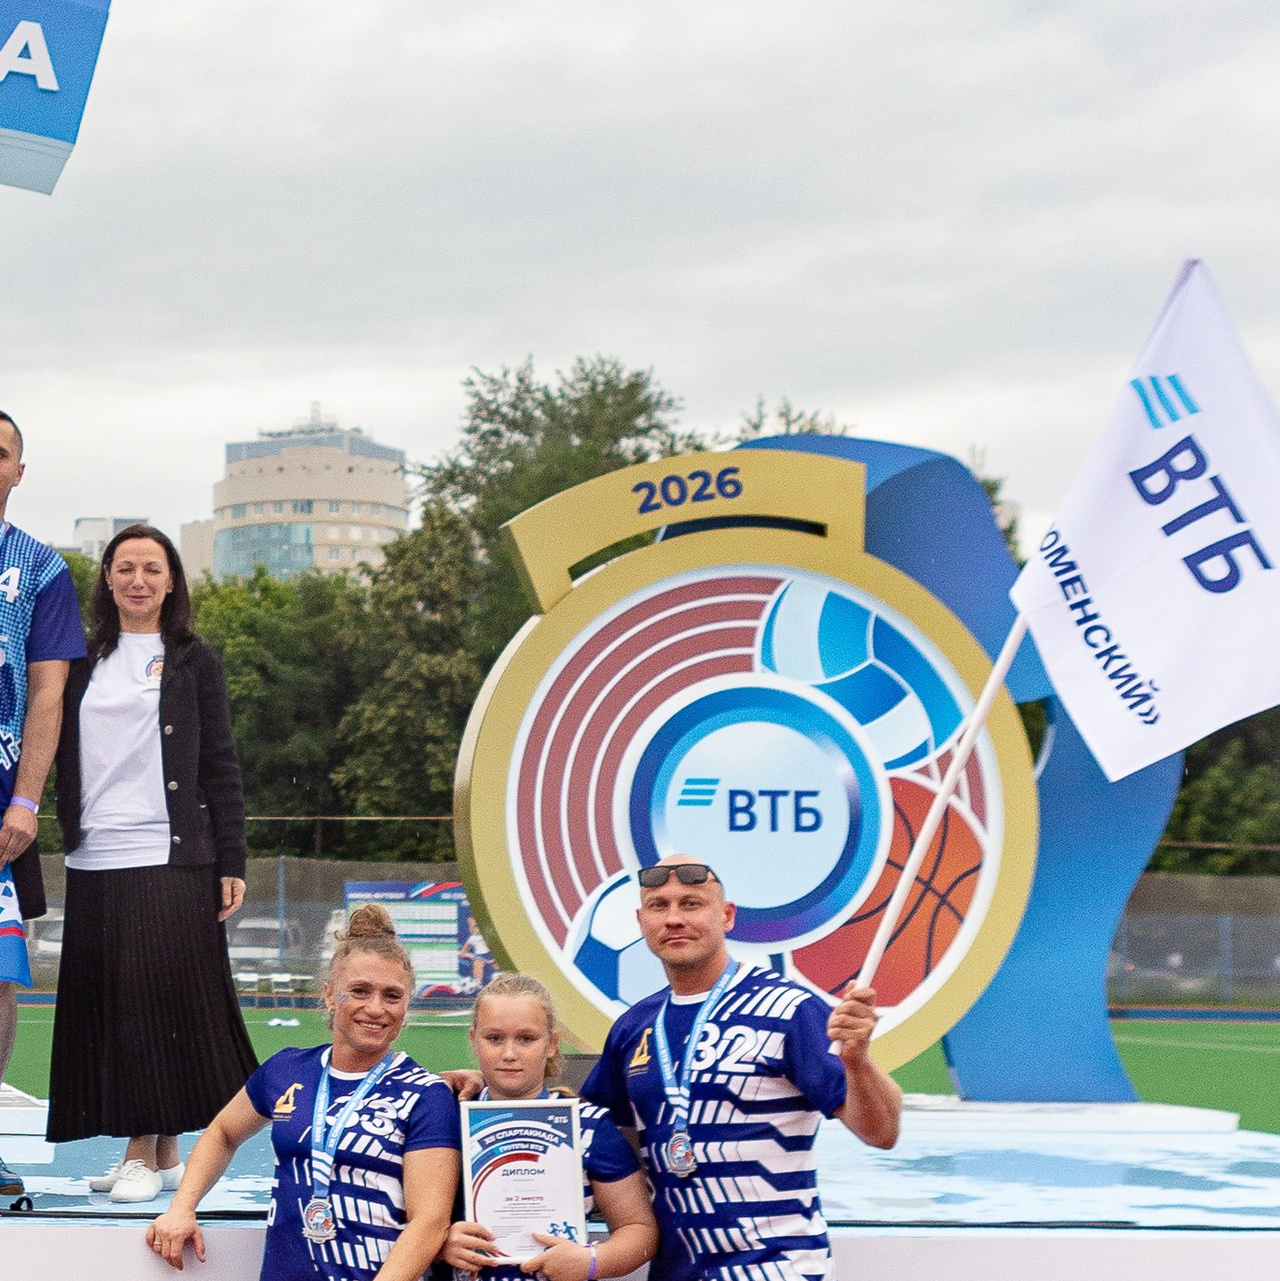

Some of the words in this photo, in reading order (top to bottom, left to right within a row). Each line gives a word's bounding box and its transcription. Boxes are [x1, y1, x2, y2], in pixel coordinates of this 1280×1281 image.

[631, 466, 743, 515] 2026
[1127, 433, 1274, 594] ВТБ
[728, 789, 823, 833] ВТБ
[692, 1022, 760, 1074] 32
[496, 1129, 560, 1143] СПАРТАКИАДА
[502, 1168, 546, 1177] ДИПЛОМ
